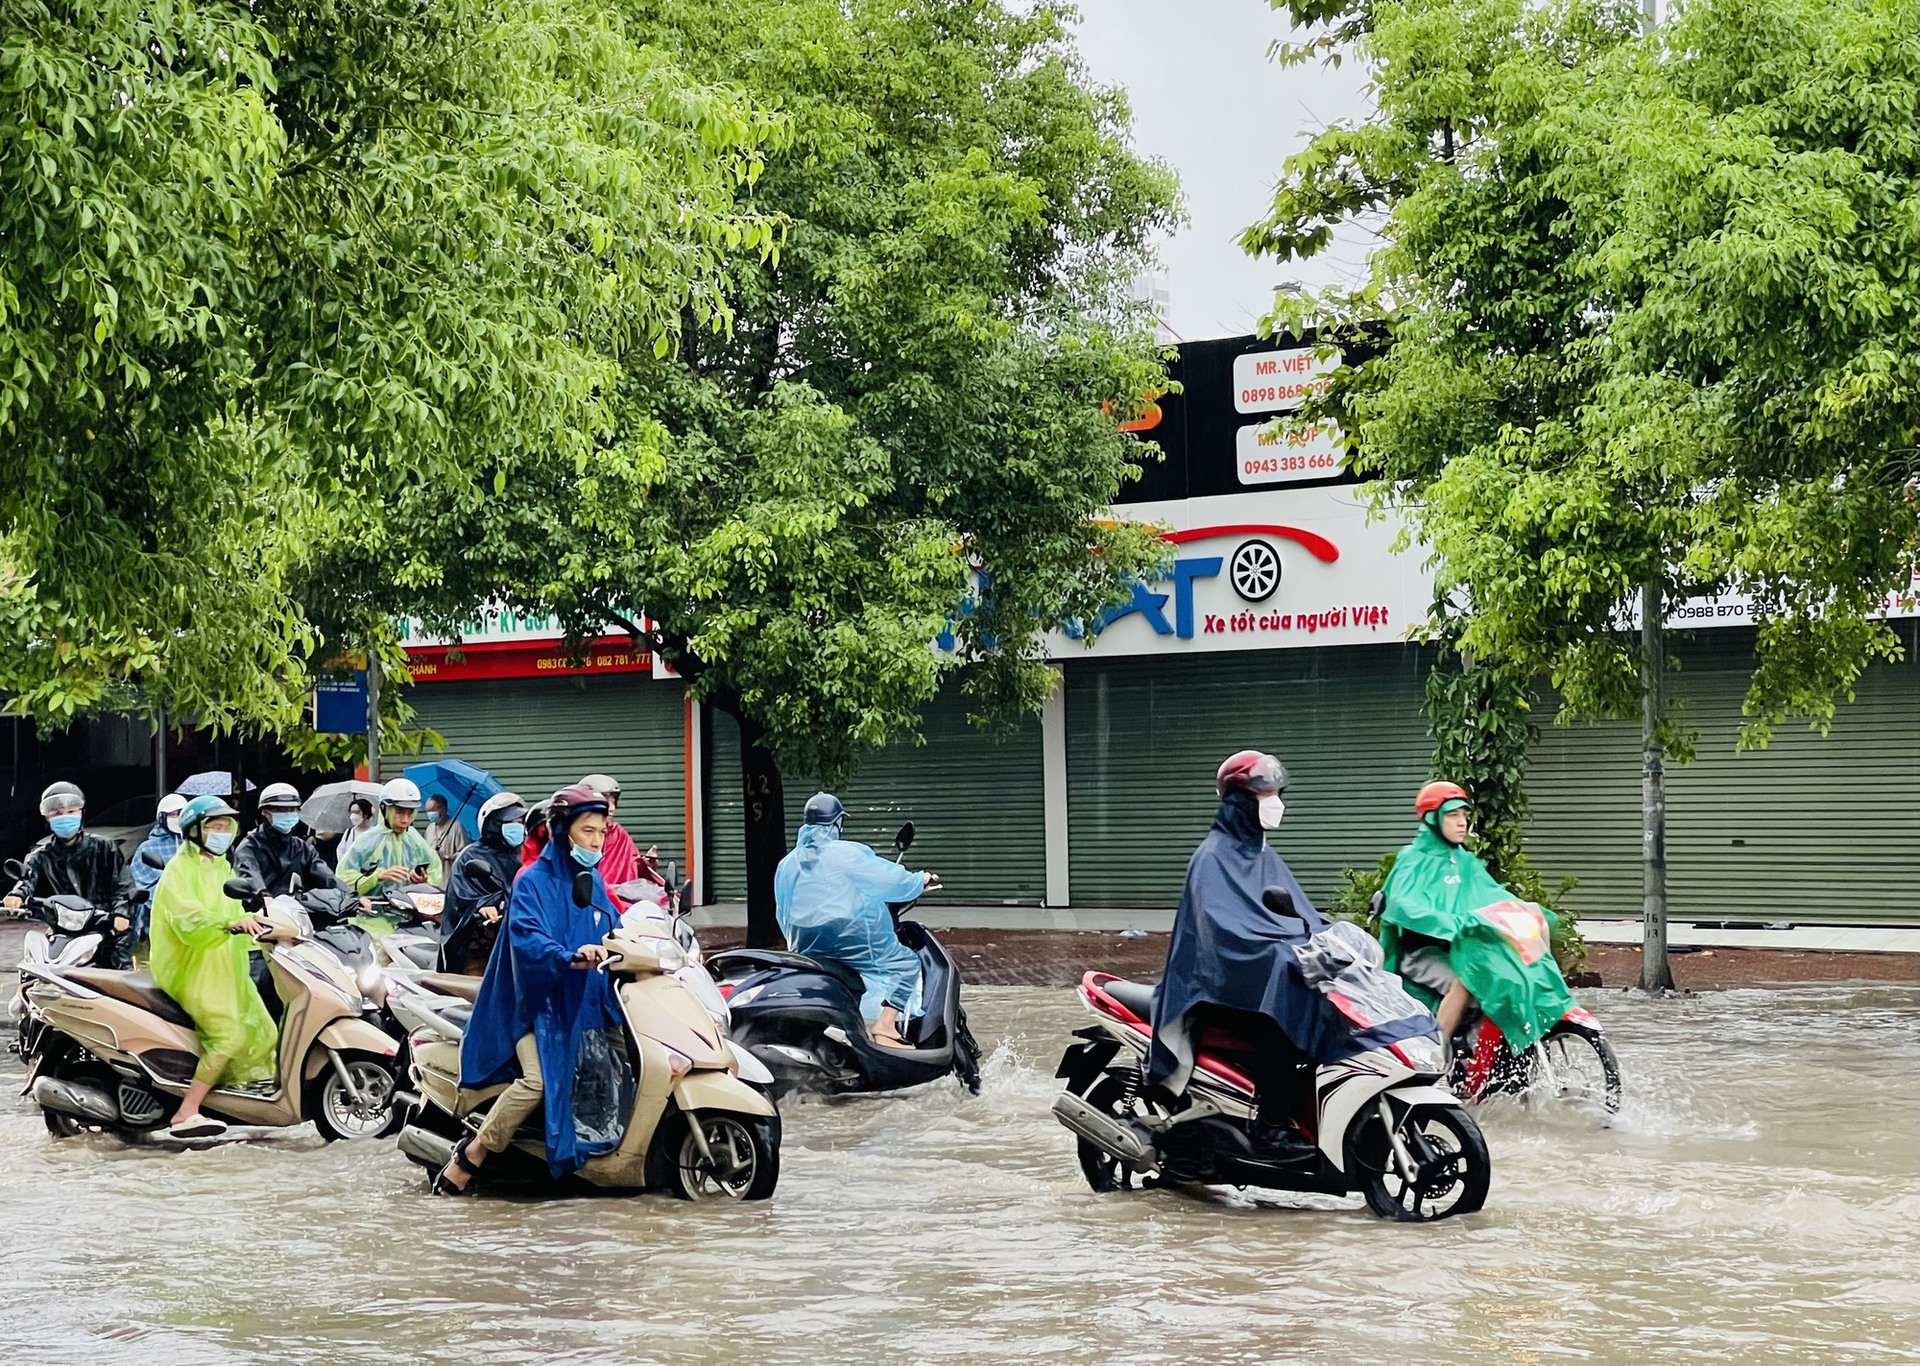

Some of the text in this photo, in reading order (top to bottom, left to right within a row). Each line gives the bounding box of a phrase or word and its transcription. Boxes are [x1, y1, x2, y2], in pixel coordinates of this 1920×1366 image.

[1256, 355, 1313, 376] MR. VIỆT
[1242, 387, 1276, 403] 0898
[1245, 454, 1334, 474] 0943 383 666
[1204, 605, 1389, 633] Xe tốt của người Việt
[1677, 607, 1714, 619] 0988
[1717, 605, 1744, 617] 870
[597, 655, 612, 667] 082
[614, 654, 628, 665] 781
